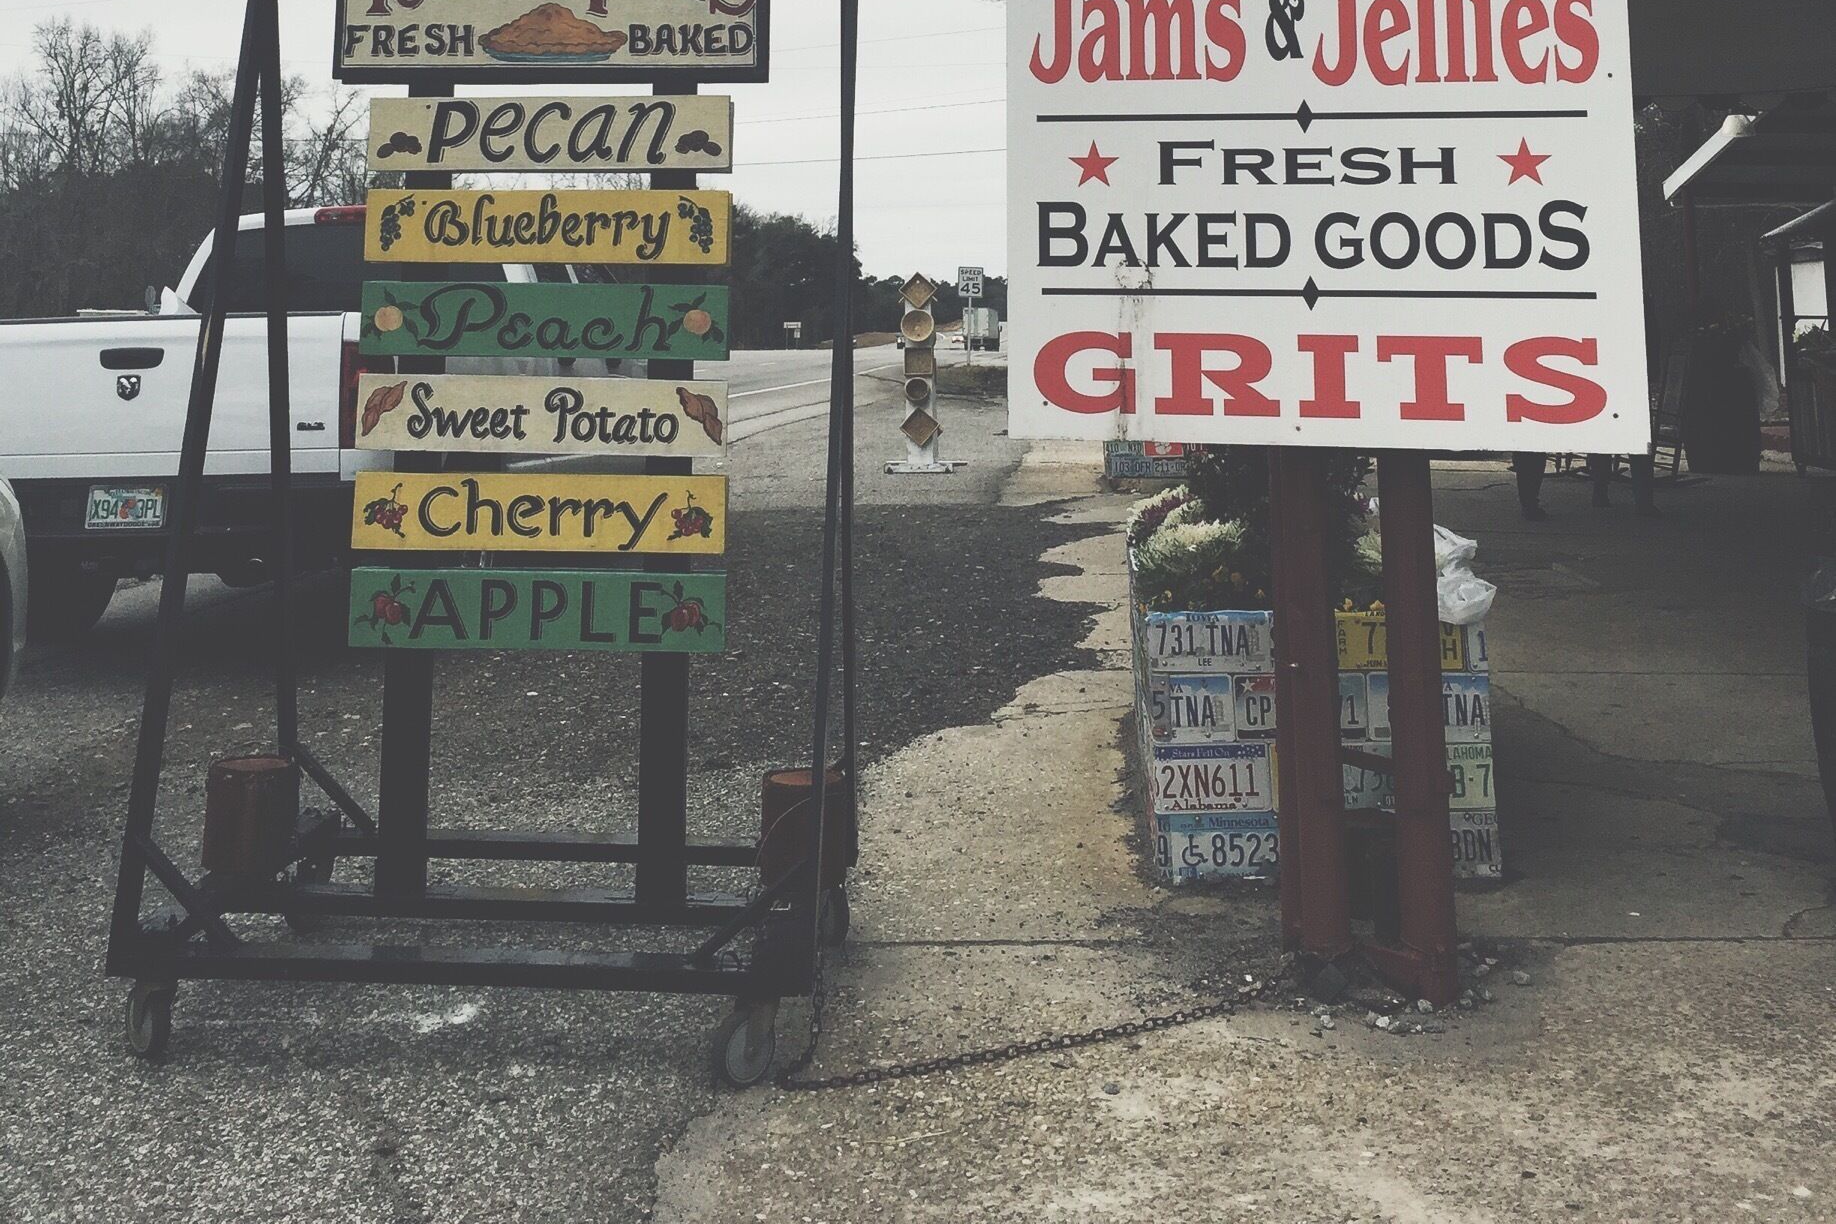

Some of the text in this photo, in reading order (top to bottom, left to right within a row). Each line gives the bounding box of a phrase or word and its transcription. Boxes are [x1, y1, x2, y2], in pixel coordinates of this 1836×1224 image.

[345, 24, 755, 57] FRESH BAKED
[1157, 139, 1457, 186] FRESH
[423, 192, 671, 260] Blueberry
[1036, 199, 1590, 271] BAKED GOODS
[960, 282, 981, 294] 45
[417, 283, 671, 352] Peach
[1033, 331, 1608, 424] GRITS
[407, 382, 679, 444] Sweet Potato
[418, 478, 668, 551] Cherry
[408, 578, 664, 645] APPLE
[1185, 613, 1220, 623] IOWA
[1156, 623, 1250, 656] 731 TNA
[1198, 657, 1212, 667] LEE
[1169, 694, 1217, 728] TNA
[1443, 693, 1486, 726] TNA
[1446, 745, 1493, 761] LAHOMA
[1170, 798, 1238, 811] Alabama
[1207, 816, 1270, 828] Minnesota
[1211, 832, 1280, 868] 8523
